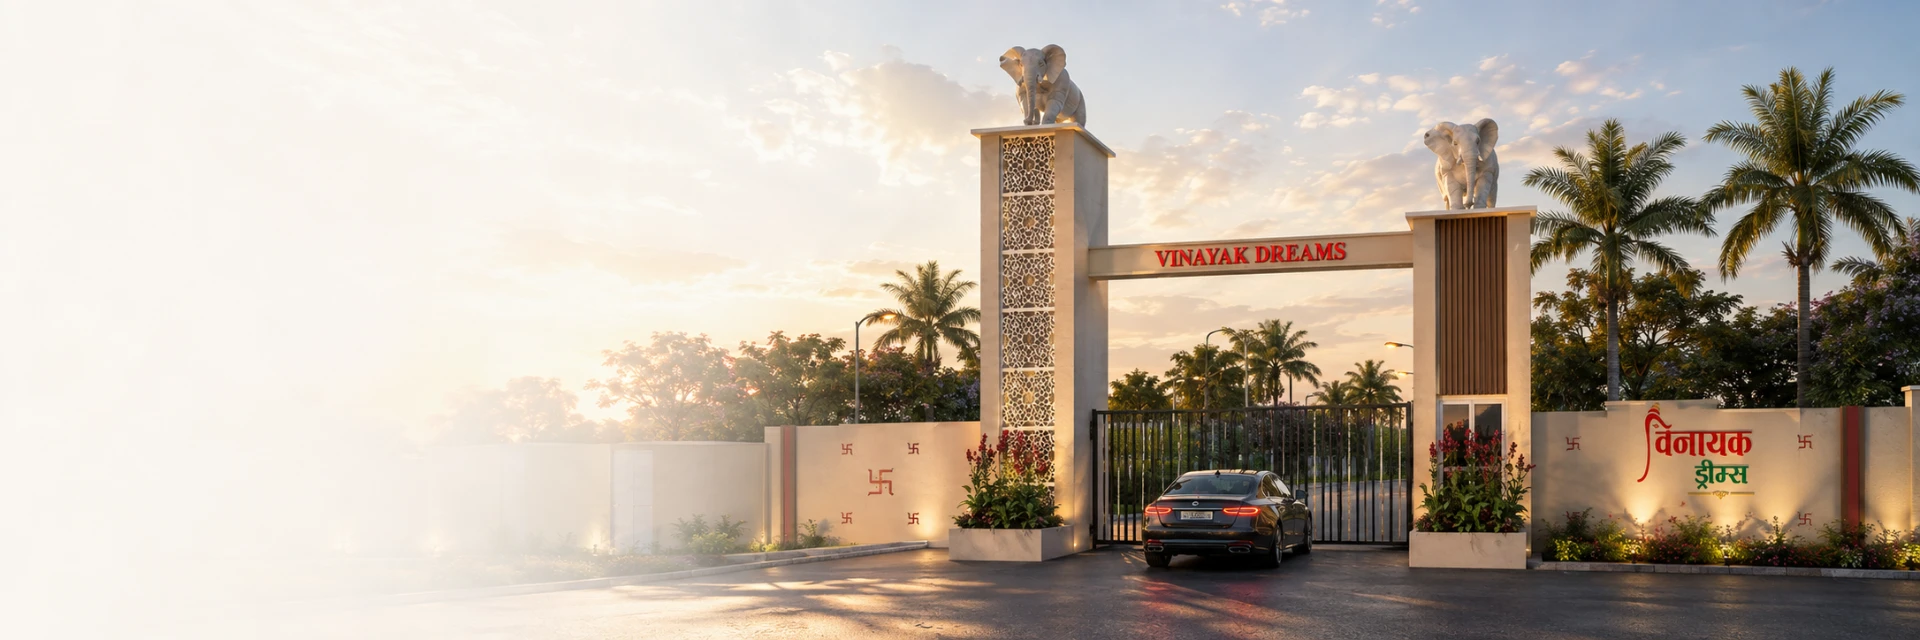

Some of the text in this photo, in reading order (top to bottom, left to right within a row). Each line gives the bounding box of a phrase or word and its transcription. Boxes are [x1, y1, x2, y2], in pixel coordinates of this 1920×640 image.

[1155, 241, 1347, 268] VINAYAK DREAMS
[1694, 459, 1749, 489] ड्रीम्स
